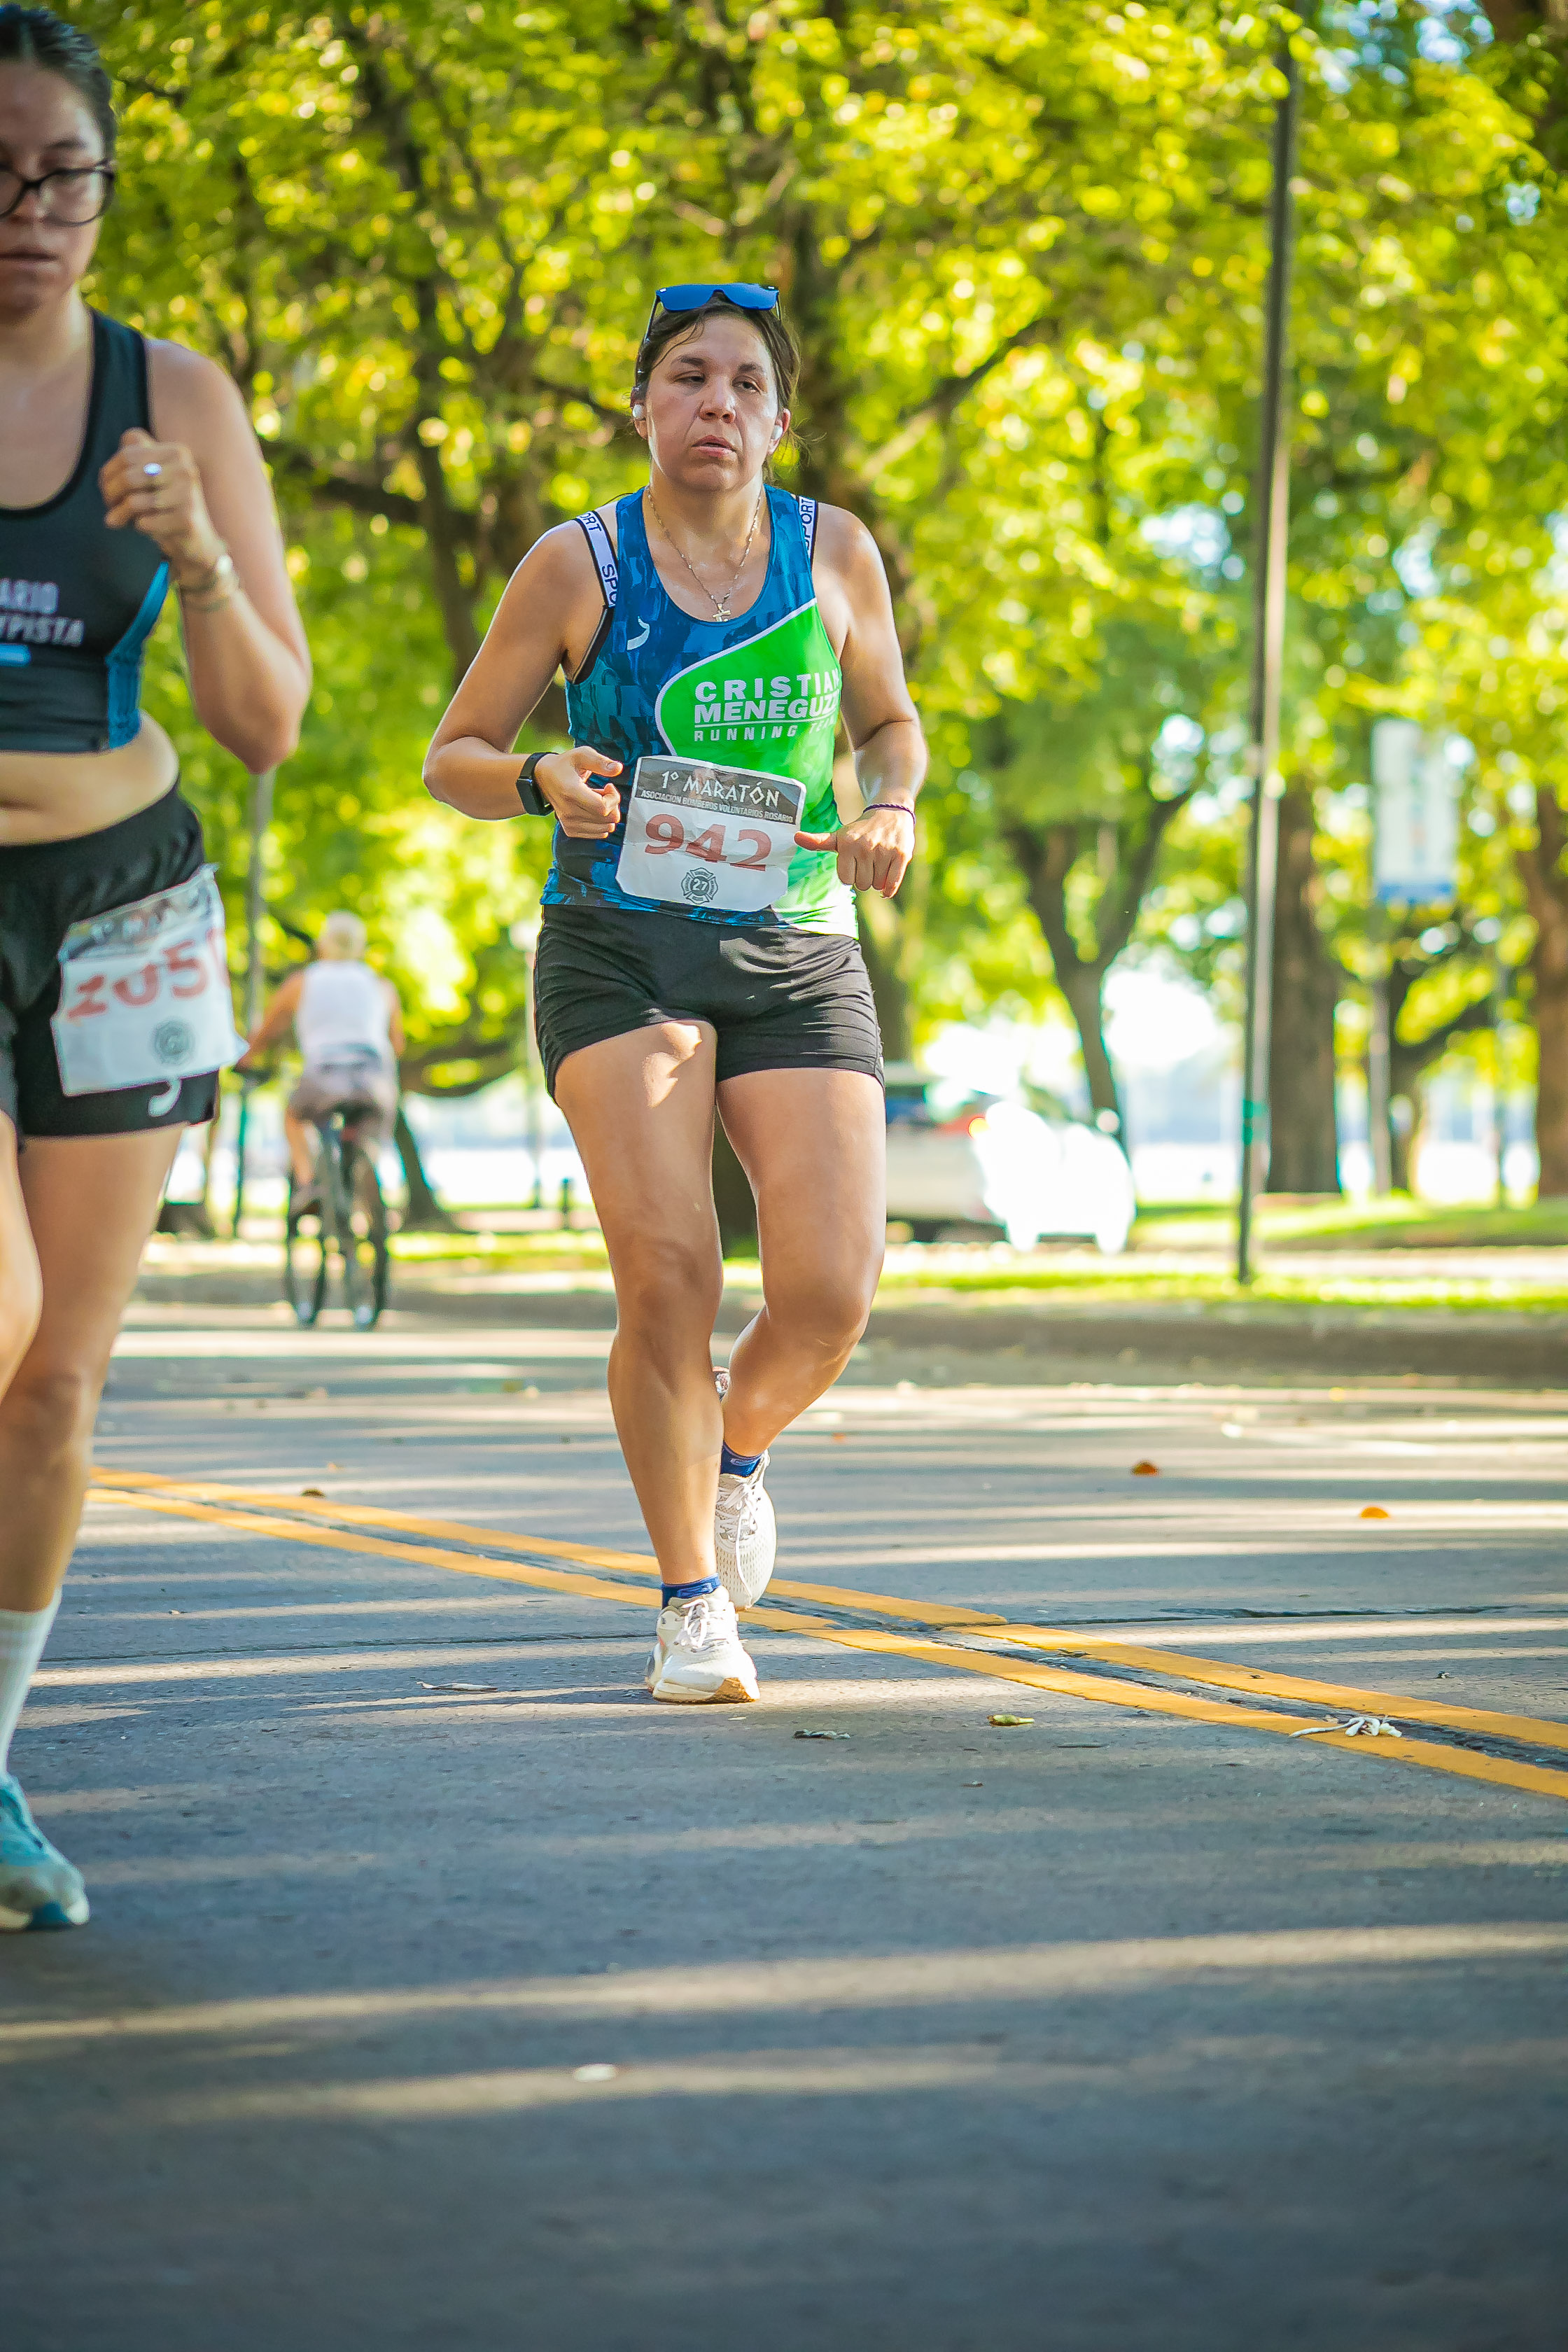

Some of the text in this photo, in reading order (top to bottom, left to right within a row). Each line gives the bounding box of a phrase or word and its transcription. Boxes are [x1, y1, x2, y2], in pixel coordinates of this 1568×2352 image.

[694, 725, 798, 742] RUNNING
[682, 775, 780, 807] MARATÓN
[682, 797, 719, 811] BOMBEROS
[718, 803, 764, 818] VOLUNTARIOS
[764, 811, 793, 823] ROSARIO
[645, 813, 772, 872] 942
[692, 878, 708, 891] 27
